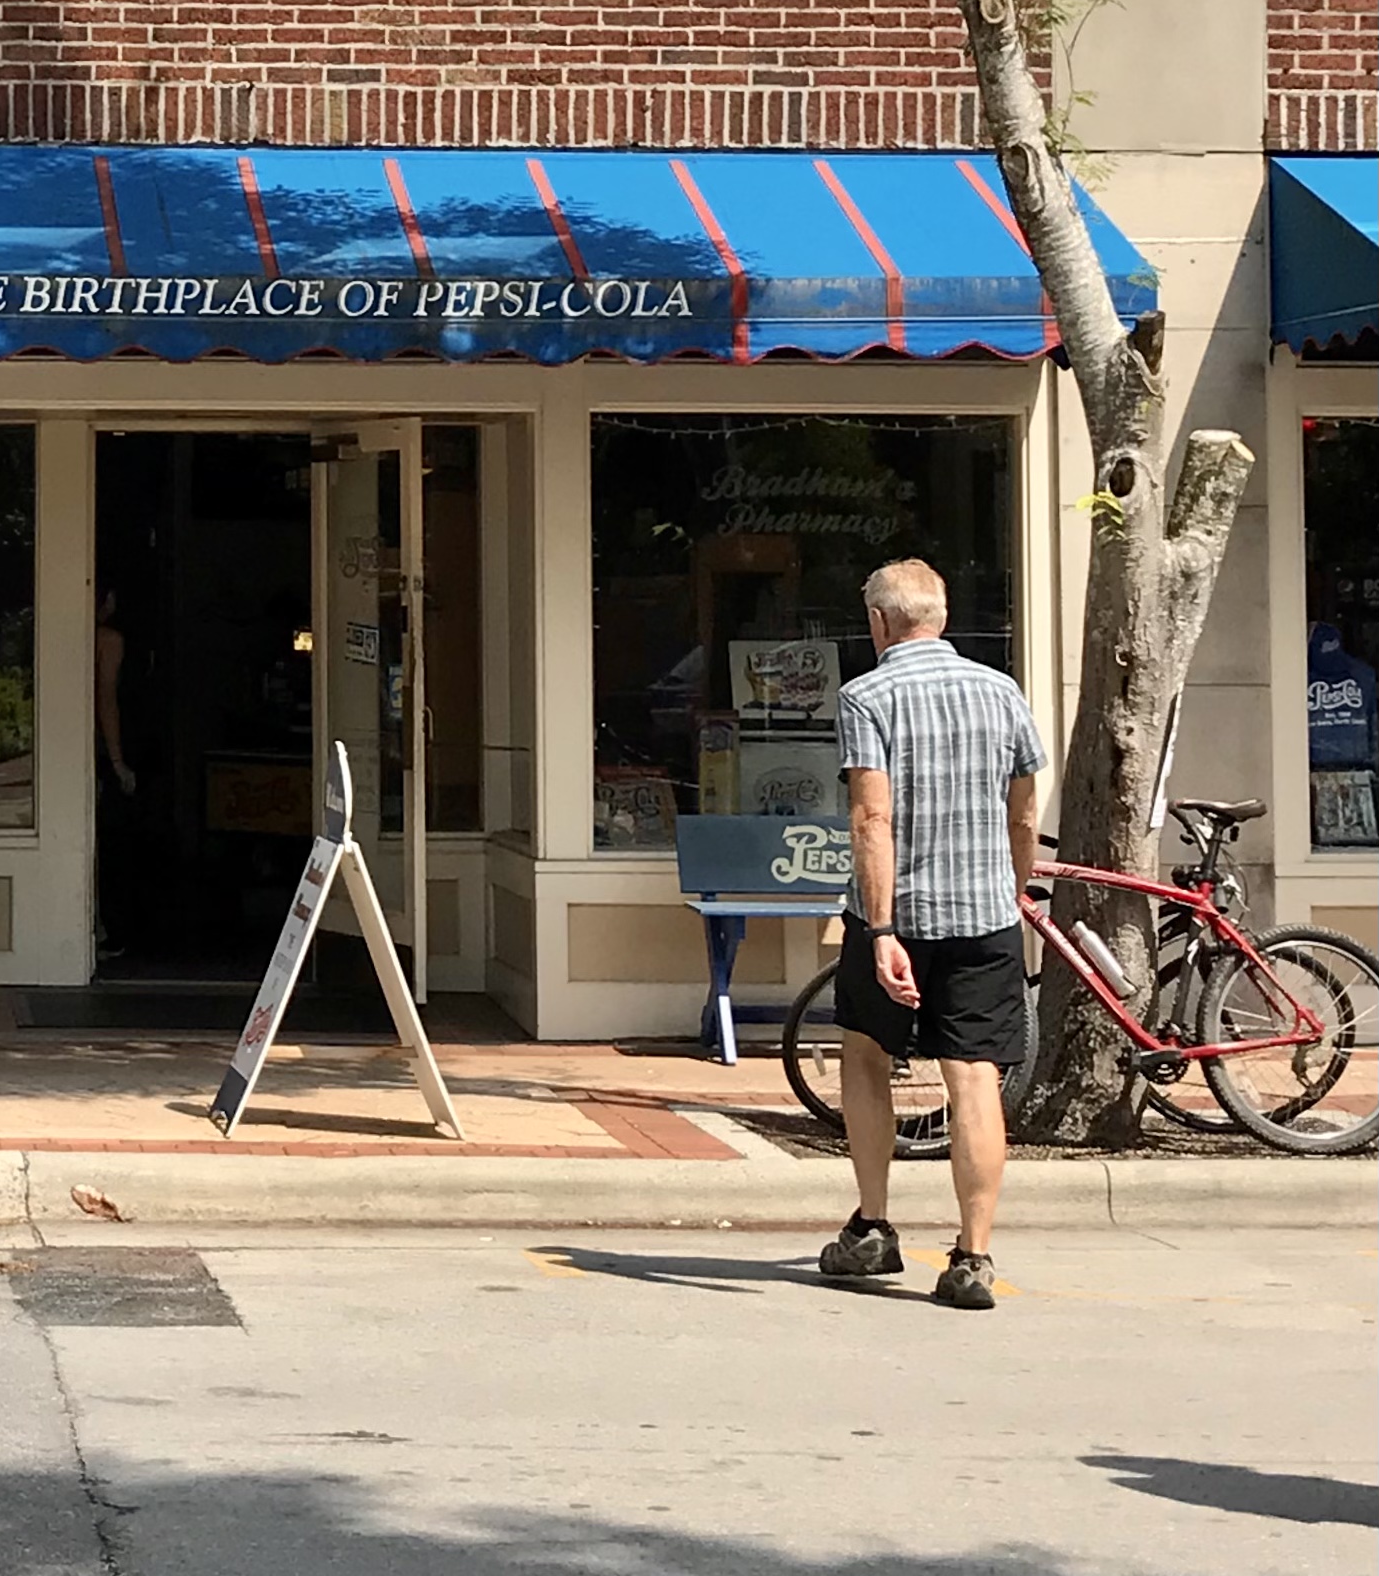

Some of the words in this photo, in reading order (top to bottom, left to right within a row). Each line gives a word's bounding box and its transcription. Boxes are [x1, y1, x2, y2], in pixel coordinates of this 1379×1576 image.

[19, 275, 325, 316] BIRTHPLACE
[337, 279, 404, 317] OF
[413, 280, 694, 318] PEPSI-COLA
